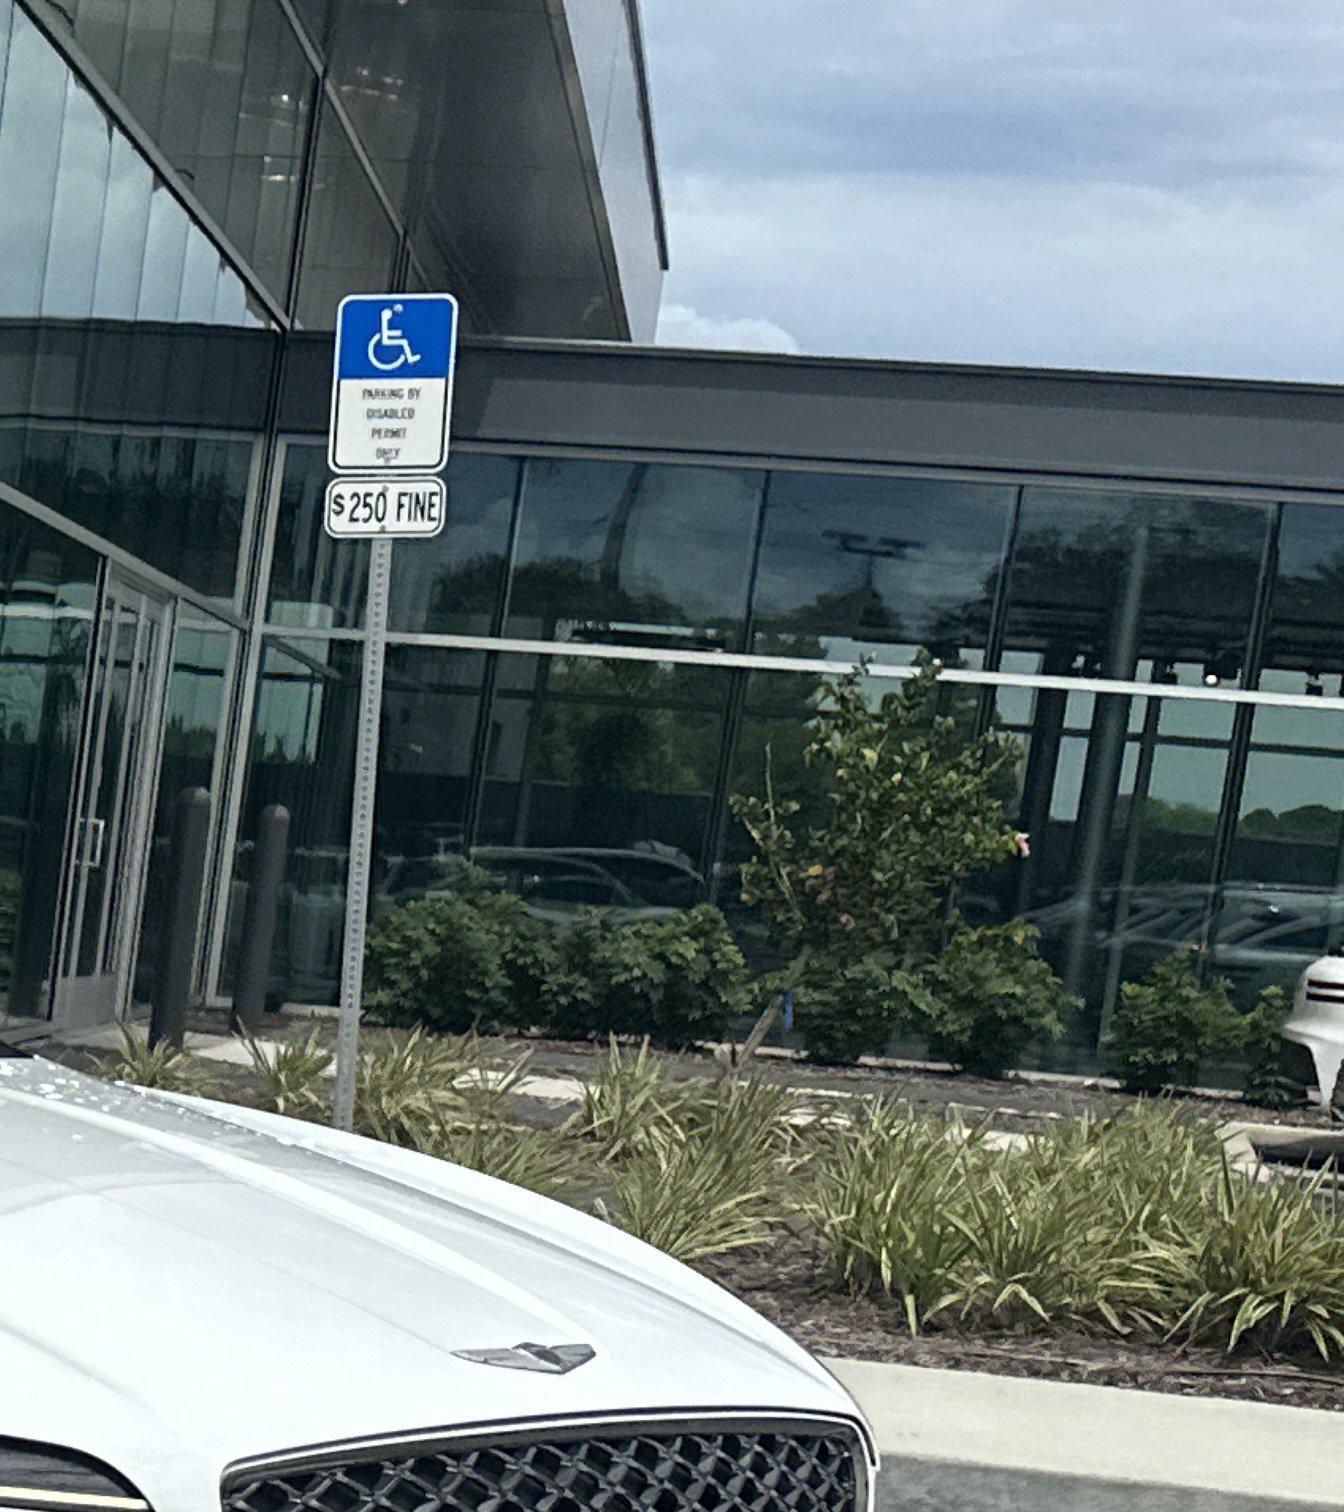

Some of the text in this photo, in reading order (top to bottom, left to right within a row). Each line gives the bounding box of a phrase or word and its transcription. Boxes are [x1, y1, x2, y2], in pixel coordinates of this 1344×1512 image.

[362, 387, 421, 400] PARKING BY
[366, 406, 415, 420] DISABLED
[371, 427, 407, 440] PERMIT
[332, 491, 439, 523] $250 FINE
